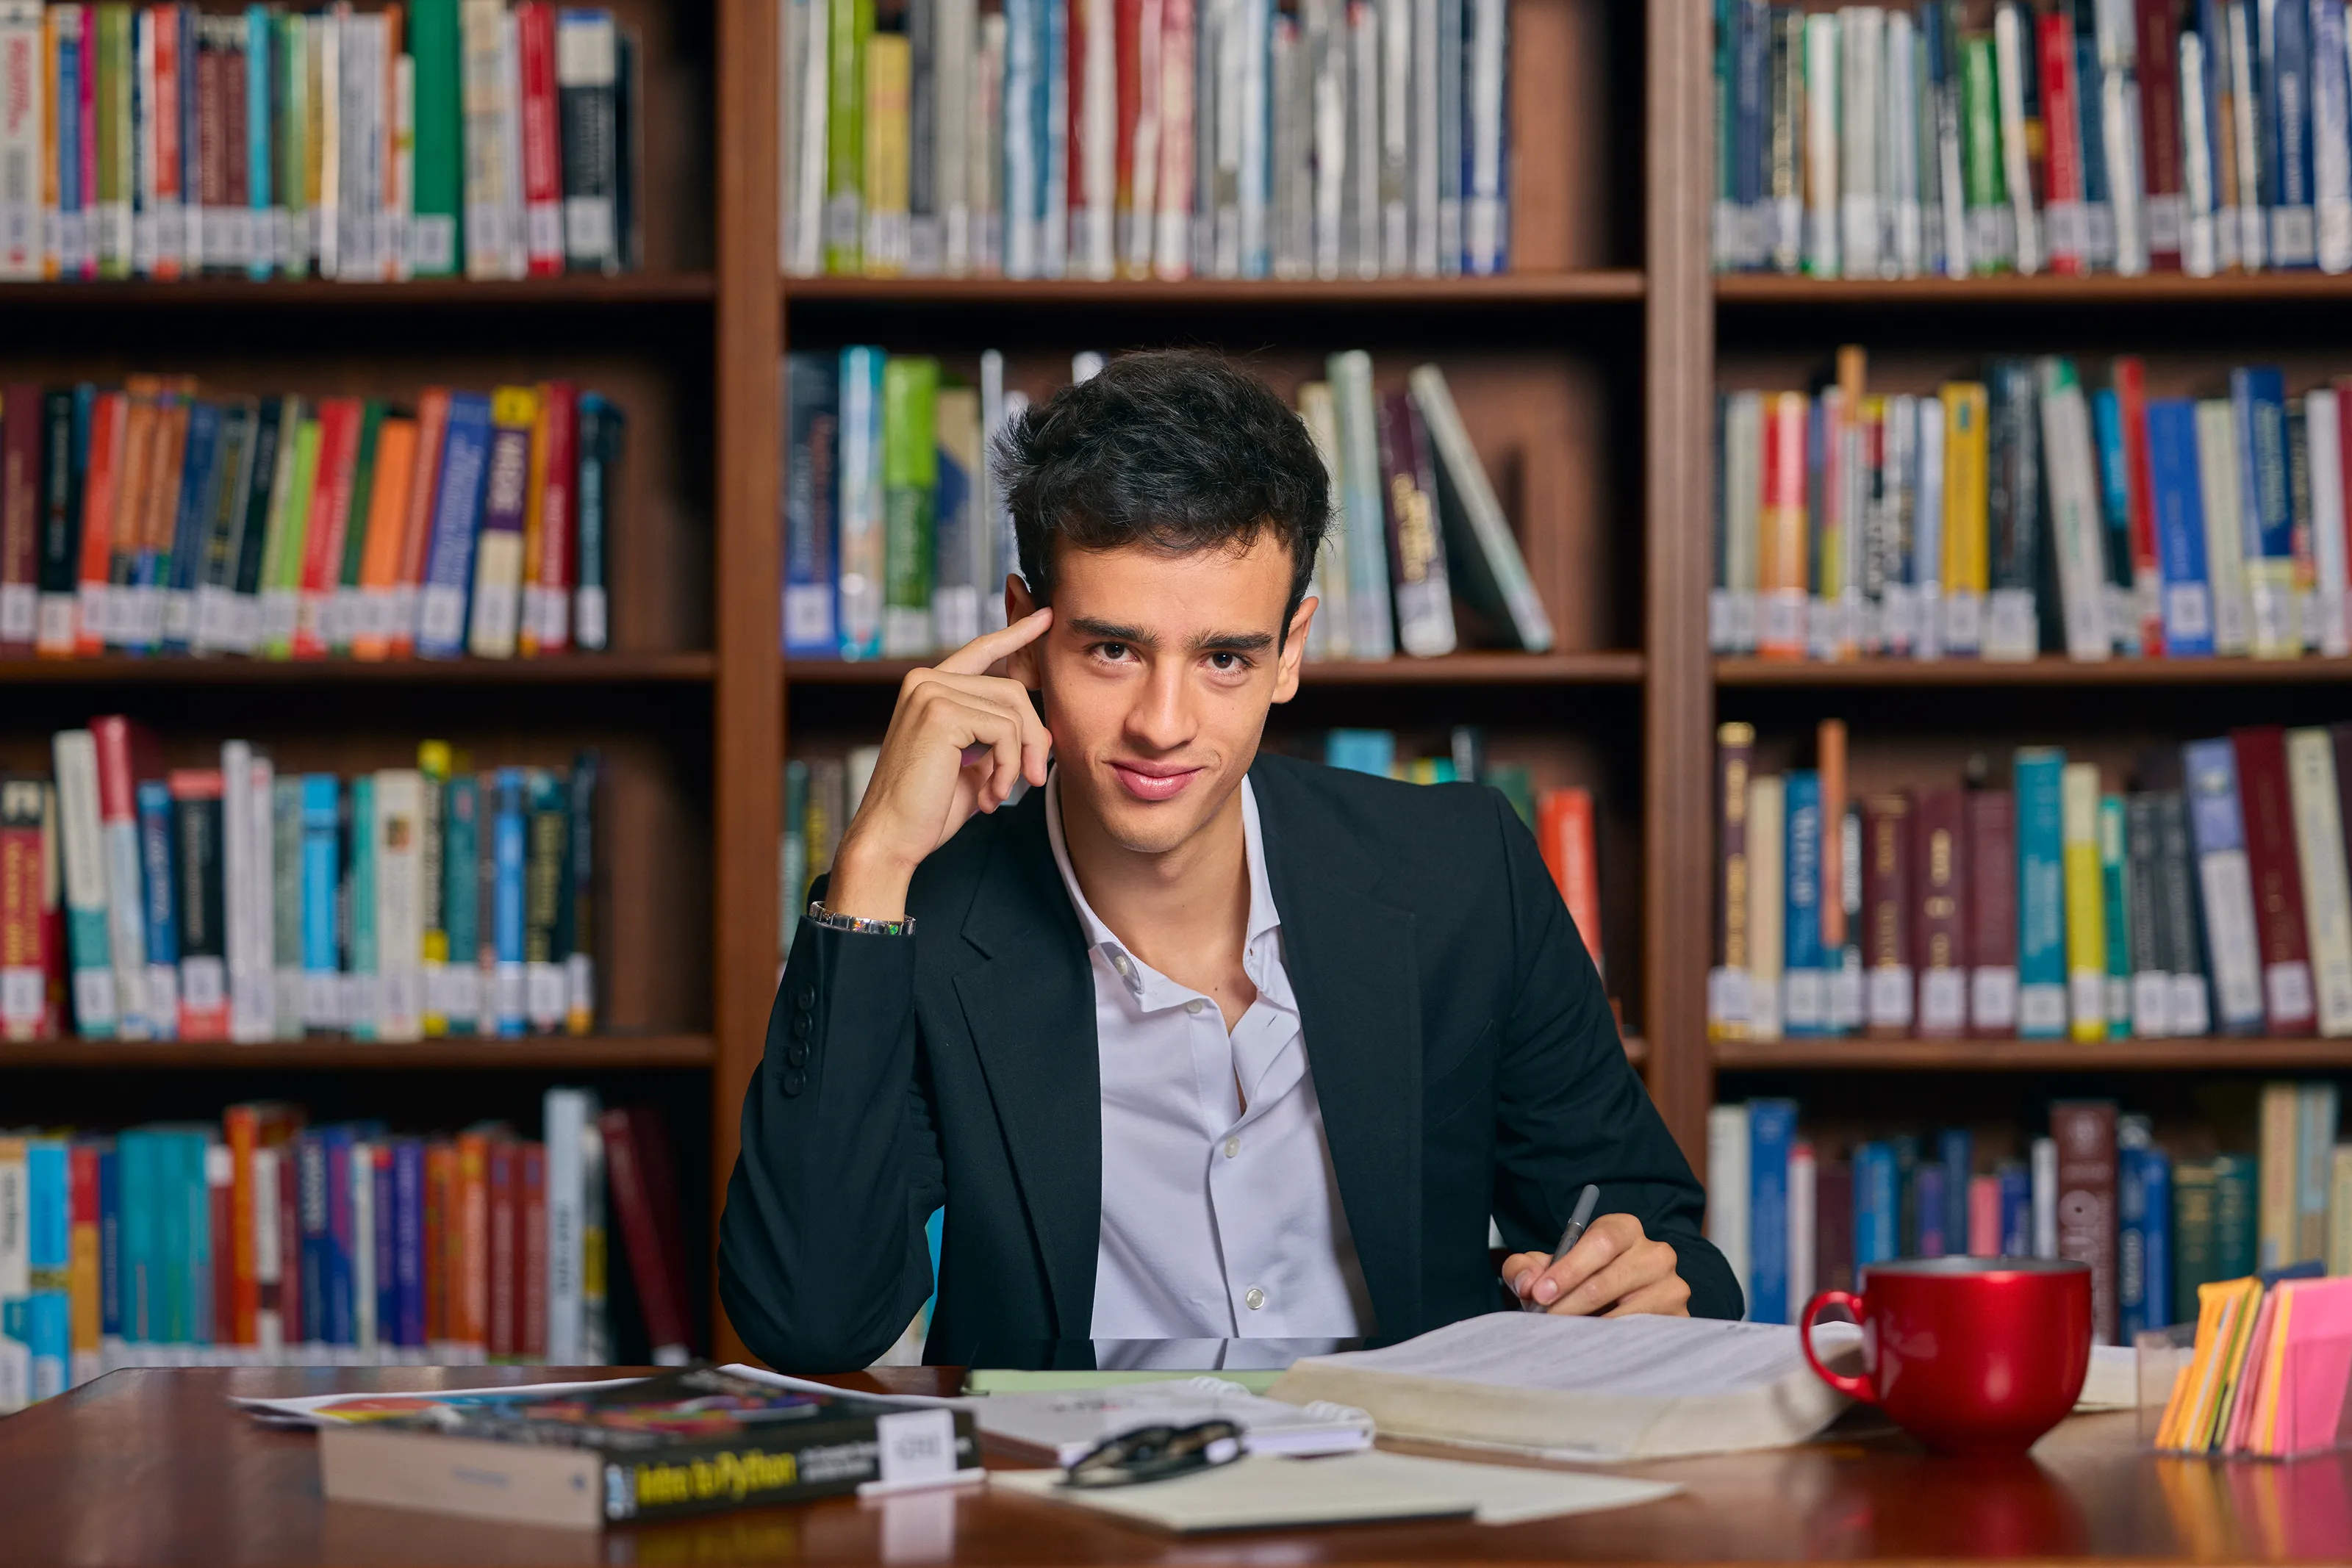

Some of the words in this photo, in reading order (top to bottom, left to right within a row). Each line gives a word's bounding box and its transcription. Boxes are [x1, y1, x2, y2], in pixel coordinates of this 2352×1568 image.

[636, 1463, 689, 1503] Intro
[691, 1458, 715, 1499] to
[715, 1449, 796, 1503] Python
